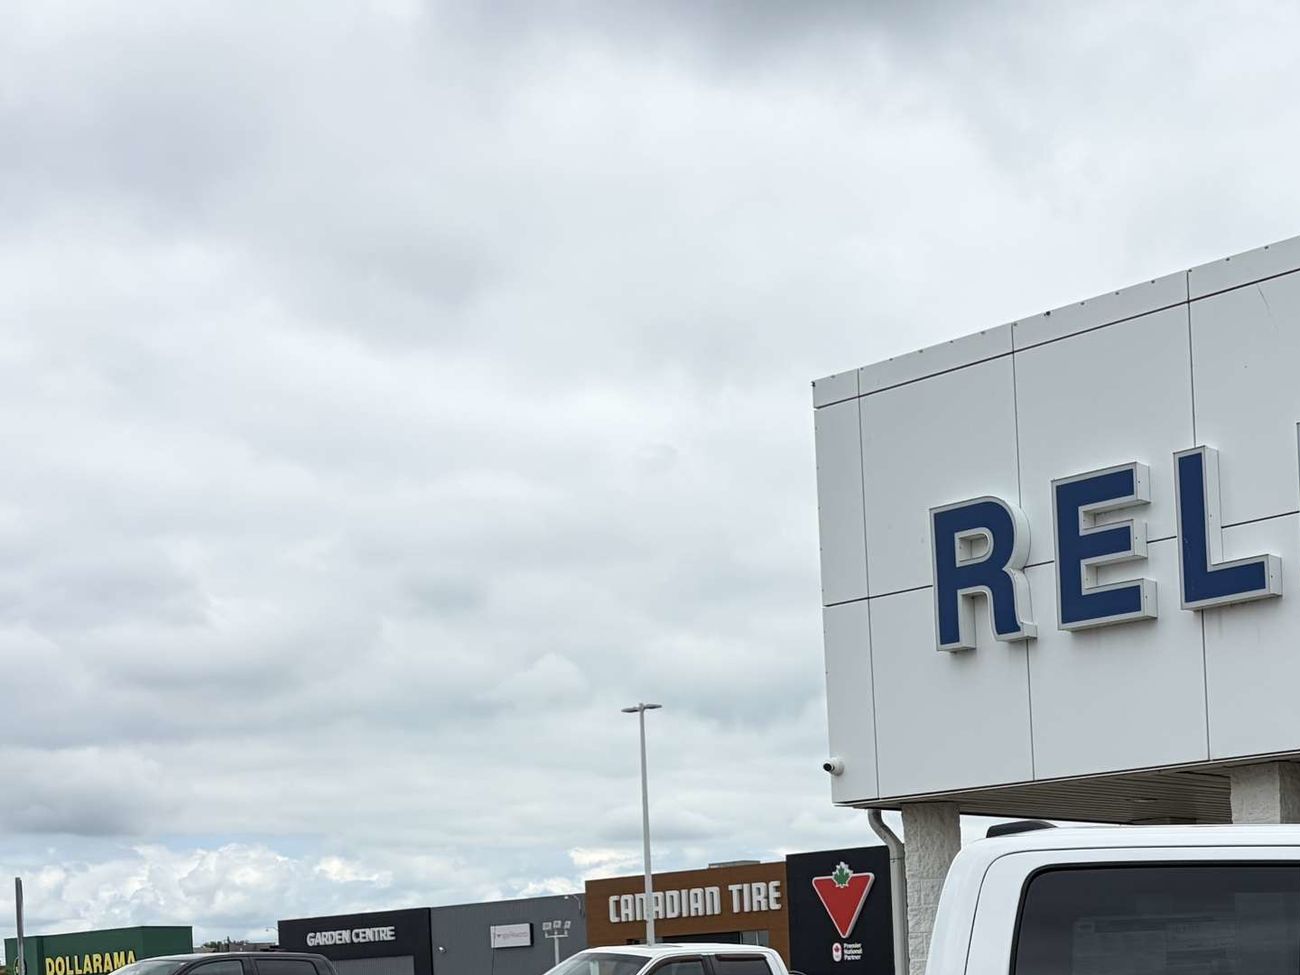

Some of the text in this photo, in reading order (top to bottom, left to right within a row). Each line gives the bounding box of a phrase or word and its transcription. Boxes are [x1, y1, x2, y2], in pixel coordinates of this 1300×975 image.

[608, 880, 782, 924] CANADIAN TIRE
[306, 926, 396, 947] GARDEN CENTRE
